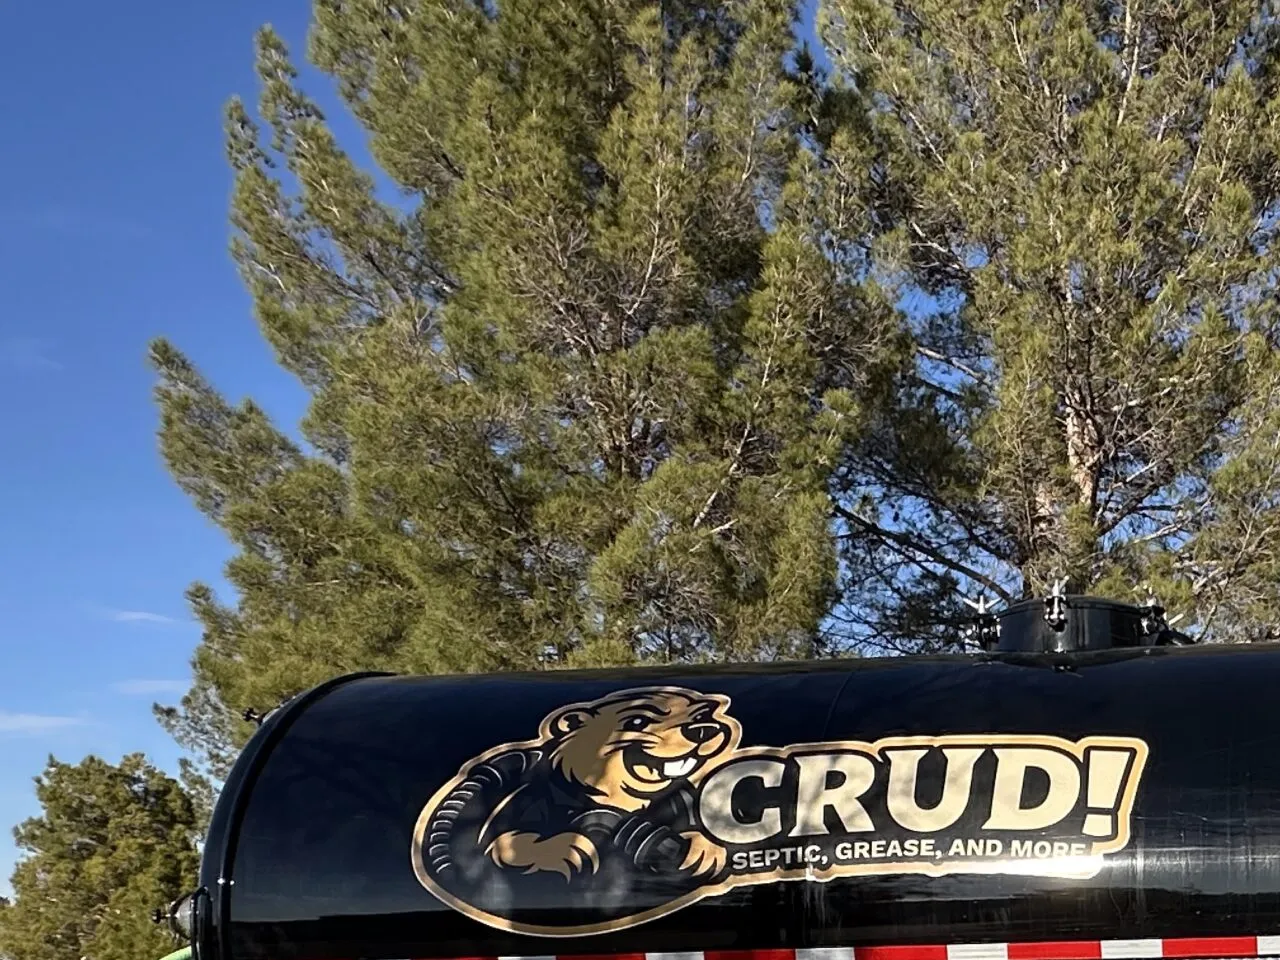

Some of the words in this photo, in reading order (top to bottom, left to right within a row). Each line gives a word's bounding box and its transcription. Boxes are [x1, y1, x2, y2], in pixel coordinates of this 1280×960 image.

[700, 748, 1128, 844] CRUD!
[731, 844, 829, 871] SEPTIC,
[835, 839, 943, 860] GREASE,
[947, 838, 1002, 858] AND
[1009, 840, 1086, 860] MORE
